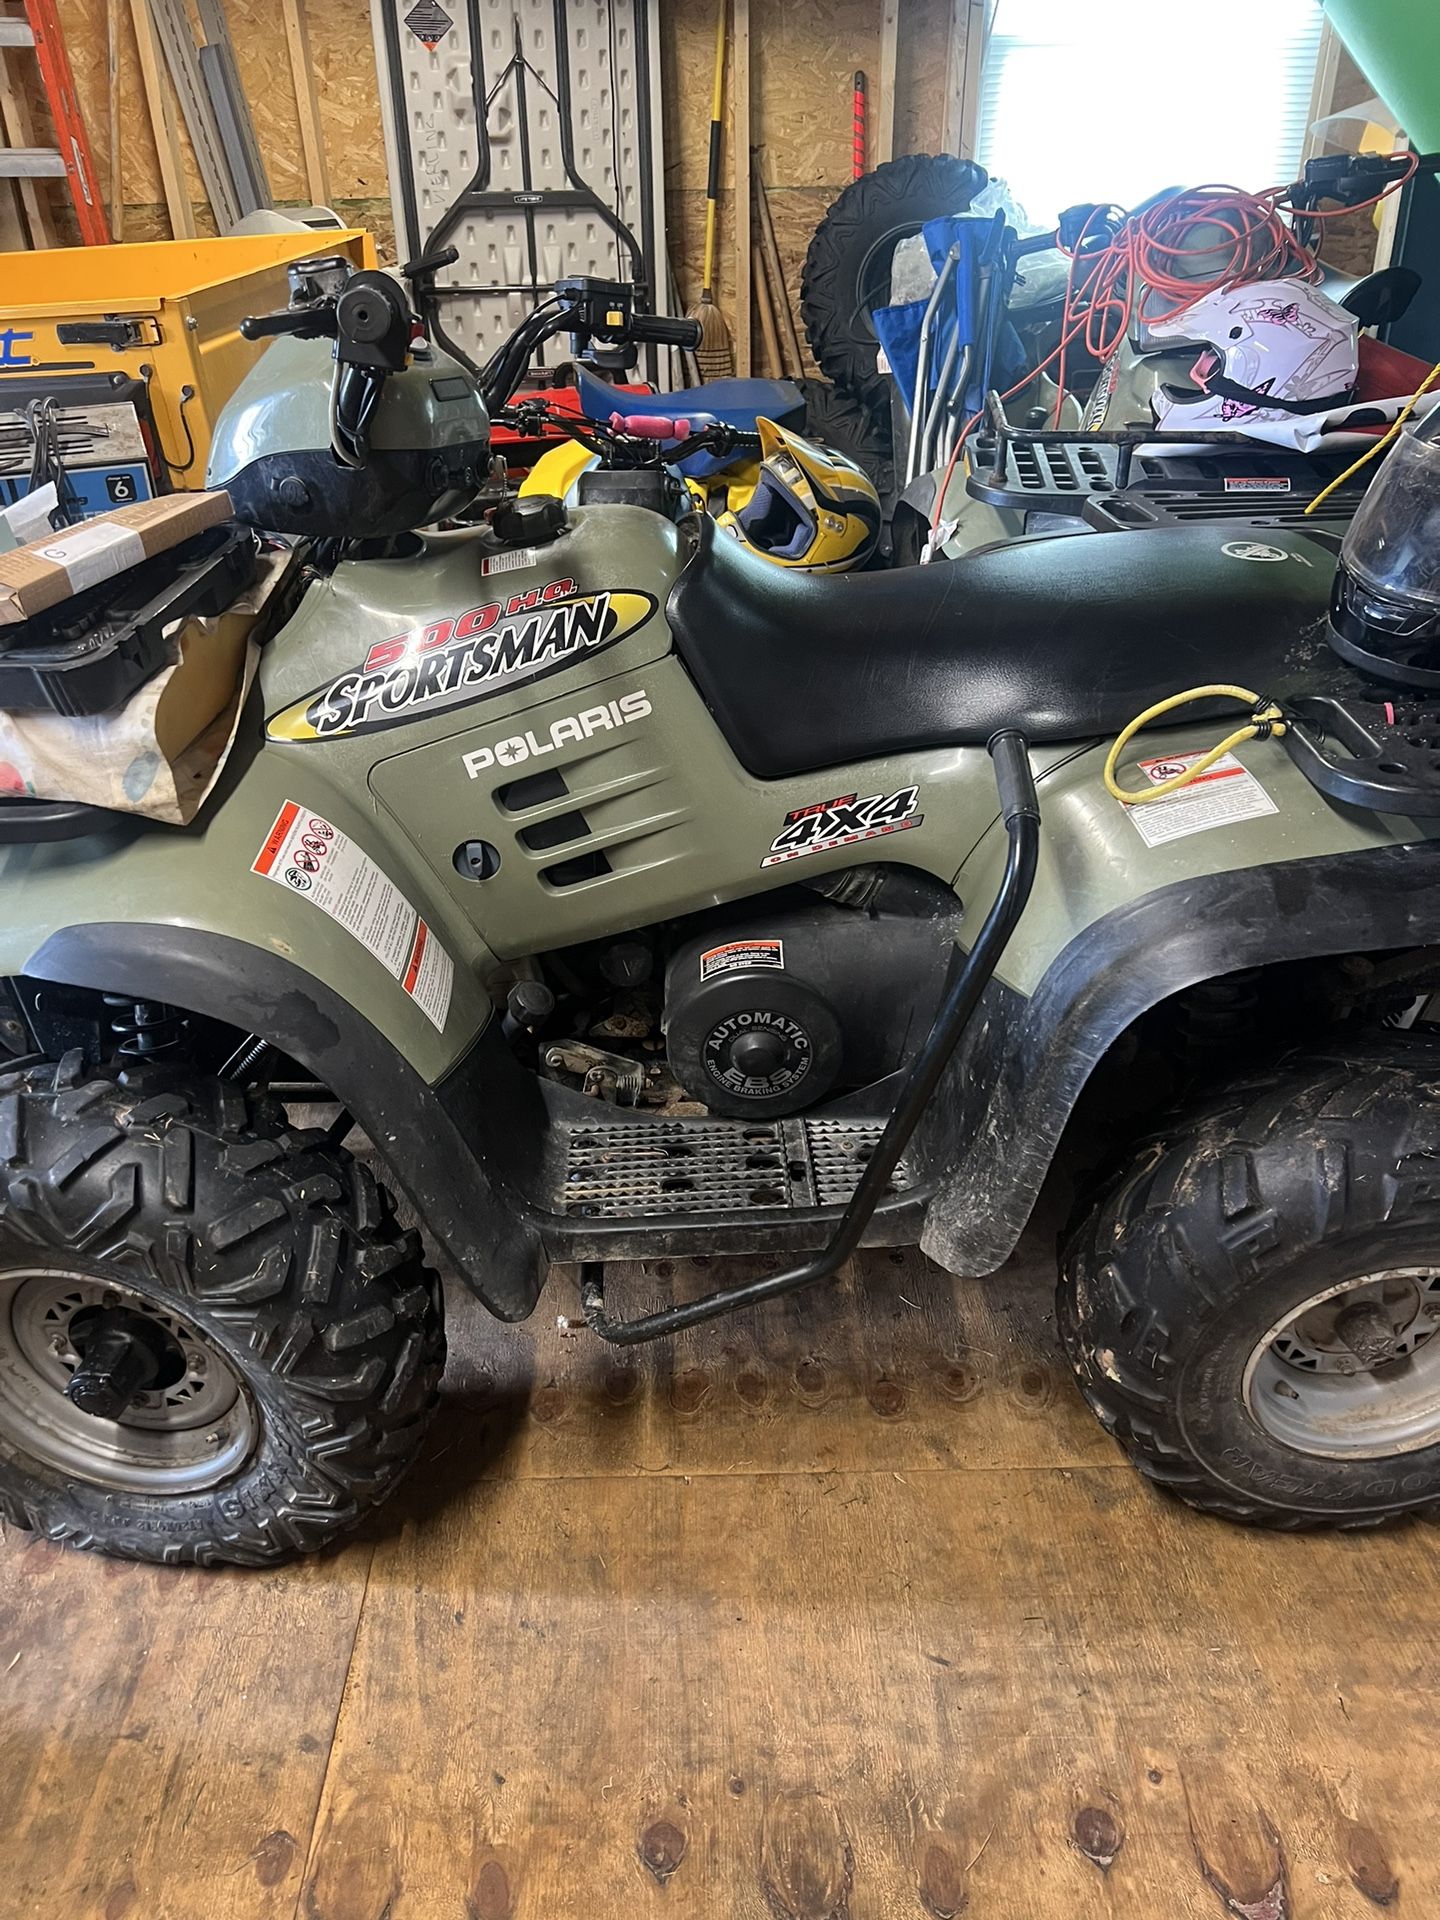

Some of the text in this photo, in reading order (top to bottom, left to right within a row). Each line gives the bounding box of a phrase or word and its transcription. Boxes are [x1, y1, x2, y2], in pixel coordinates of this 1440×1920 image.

[114, 480, 129, 498] 6
[363, 602, 503, 673] 500
[315, 592, 612, 735] SPORTSMAN
[462, 689, 653, 780] POLARIS
[770, 784, 920, 851] 4X4
[788, 795, 856, 819] TRUE
[708, 1012, 808, 1051] AUTOMATIC
[707, 1057, 809, 1095] ENGINE BRAKING SYSTEM
[723, 1067, 792, 1088] EBS
